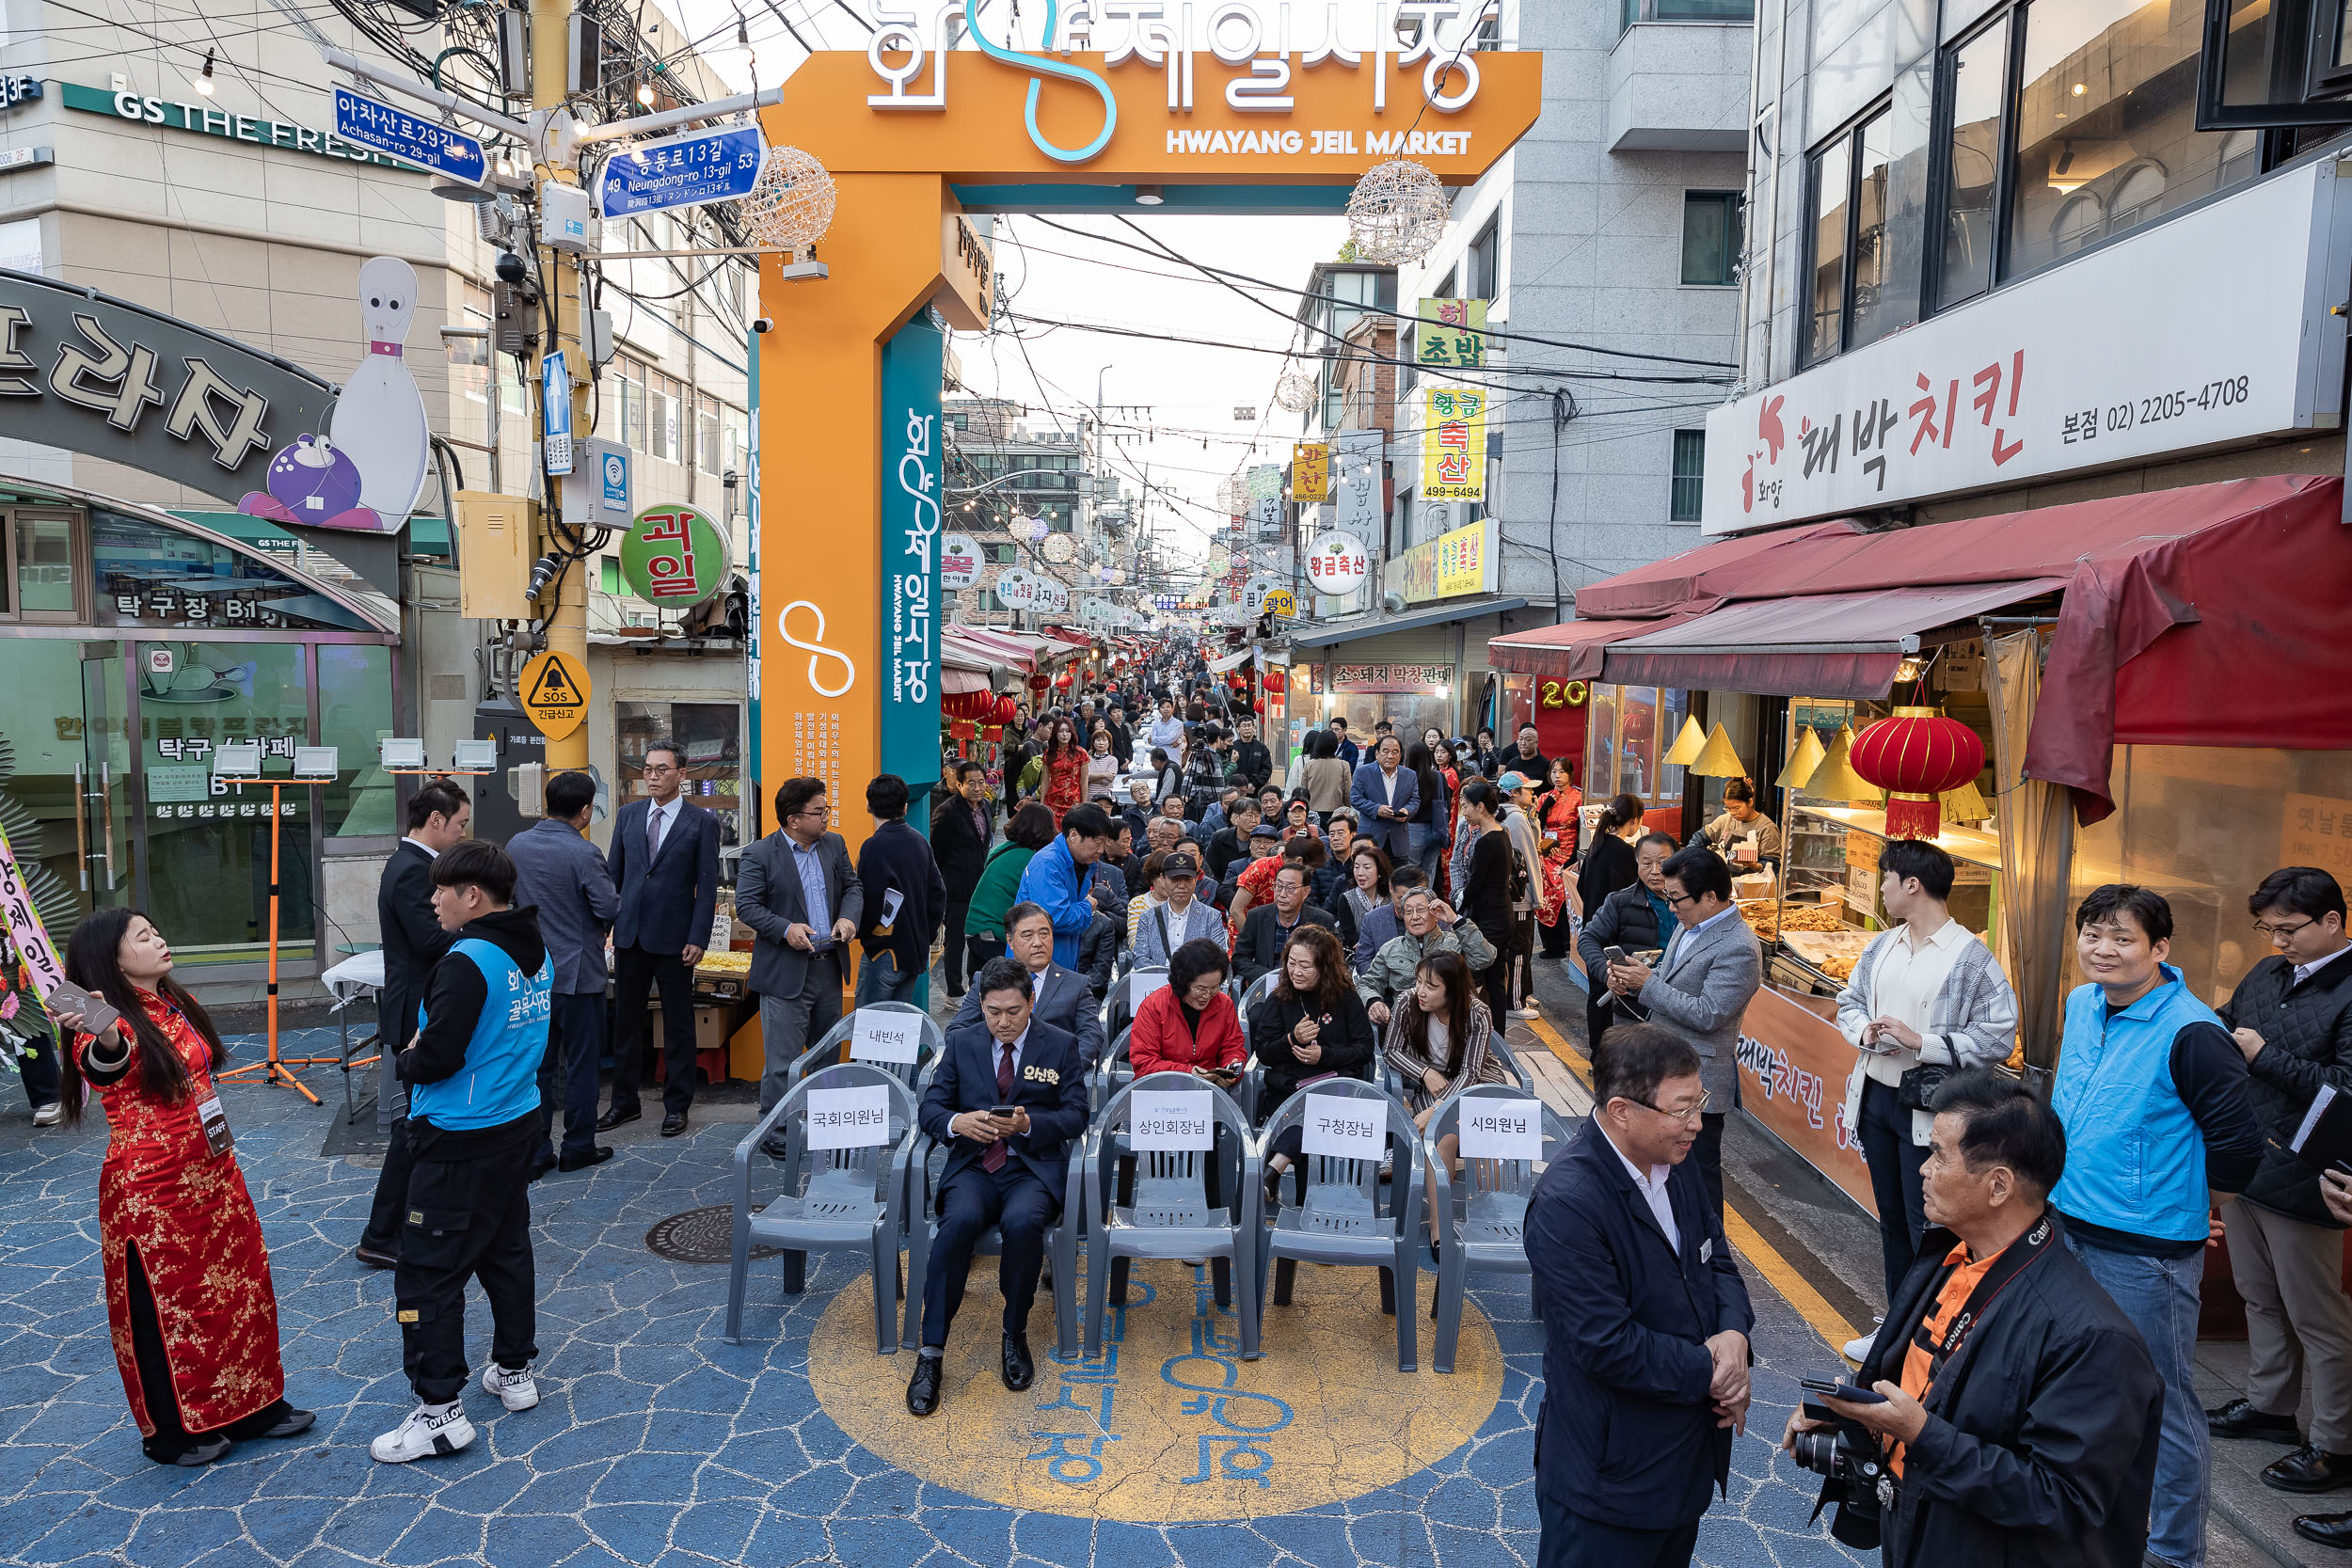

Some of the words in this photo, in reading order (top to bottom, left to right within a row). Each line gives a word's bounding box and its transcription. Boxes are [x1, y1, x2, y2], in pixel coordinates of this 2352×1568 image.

[114, 91, 165, 123] GS
[174, 101, 259, 142] THE
[338, 97, 454, 158] 아차산로29길
[341, 121, 406, 153] Achasan-ro
[410, 145, 440, 166] 29-gil
[1167, 131, 1304, 156] HWAYANG
[1311, 131, 1359, 156] JEIL
[1365, 131, 1471, 156] MARKET
[738, 152, 754, 170] 53
[607, 177, 621, 194] 49
[628, 170, 699, 193] Neungdong-ro
[703, 161, 731, 180] 13-gil
[1420, 334, 1484, 368] 초밥
[1432, 390, 1483, 418] 황금
[2060, 407, 2099, 446] 본점
[2139, 374, 2249, 427] 2205-4708
[1437, 420, 1470, 485] 축산
[1425, 486, 1481, 498] 499-6494
[1758, 478, 1783, 509] 화양
[258, 539, 270, 547] GS
[272, 539, 291, 547] THE
[642, 512, 700, 598] 과일
[898, 407, 941, 704] 화양제일시장
[1310, 555, 1365, 577] 황금축산
[117, 594, 210, 621] 탁구장
[226, 599, 256, 619] B1
[893, 575, 902, 634] HWAYANG
[1265, 595, 1293, 612] 광어
[893, 635, 902, 657] JEIL
[893, 659, 902, 704] MARKET
[1336, 666, 1389, 684] 소·돼지
[1393, 665, 1452, 685] 막창판매
[543, 692, 568, 703] SOS
[1542, 680, 1588, 710] 20
[538, 709, 575, 720] 긴급신고
[158, 737, 212, 761] 탁구
[794, 713, 803, 776] 화양제일시장의
[209, 775, 243, 796] B1
[509, 989, 550, 1022] 골목시장
[869, 1029, 904, 1045] 내빈석
[1024, 1065, 1060, 1085] 오신환
[812, 1108, 883, 1128] 국회의원님
[1138, 1119, 1206, 1136] 상인회장님
[1316, 1117, 1374, 1138] 구청장님
[1470, 1117, 1527, 1133] 시의원님
[1945, 1312, 1972, 1352] Canon
